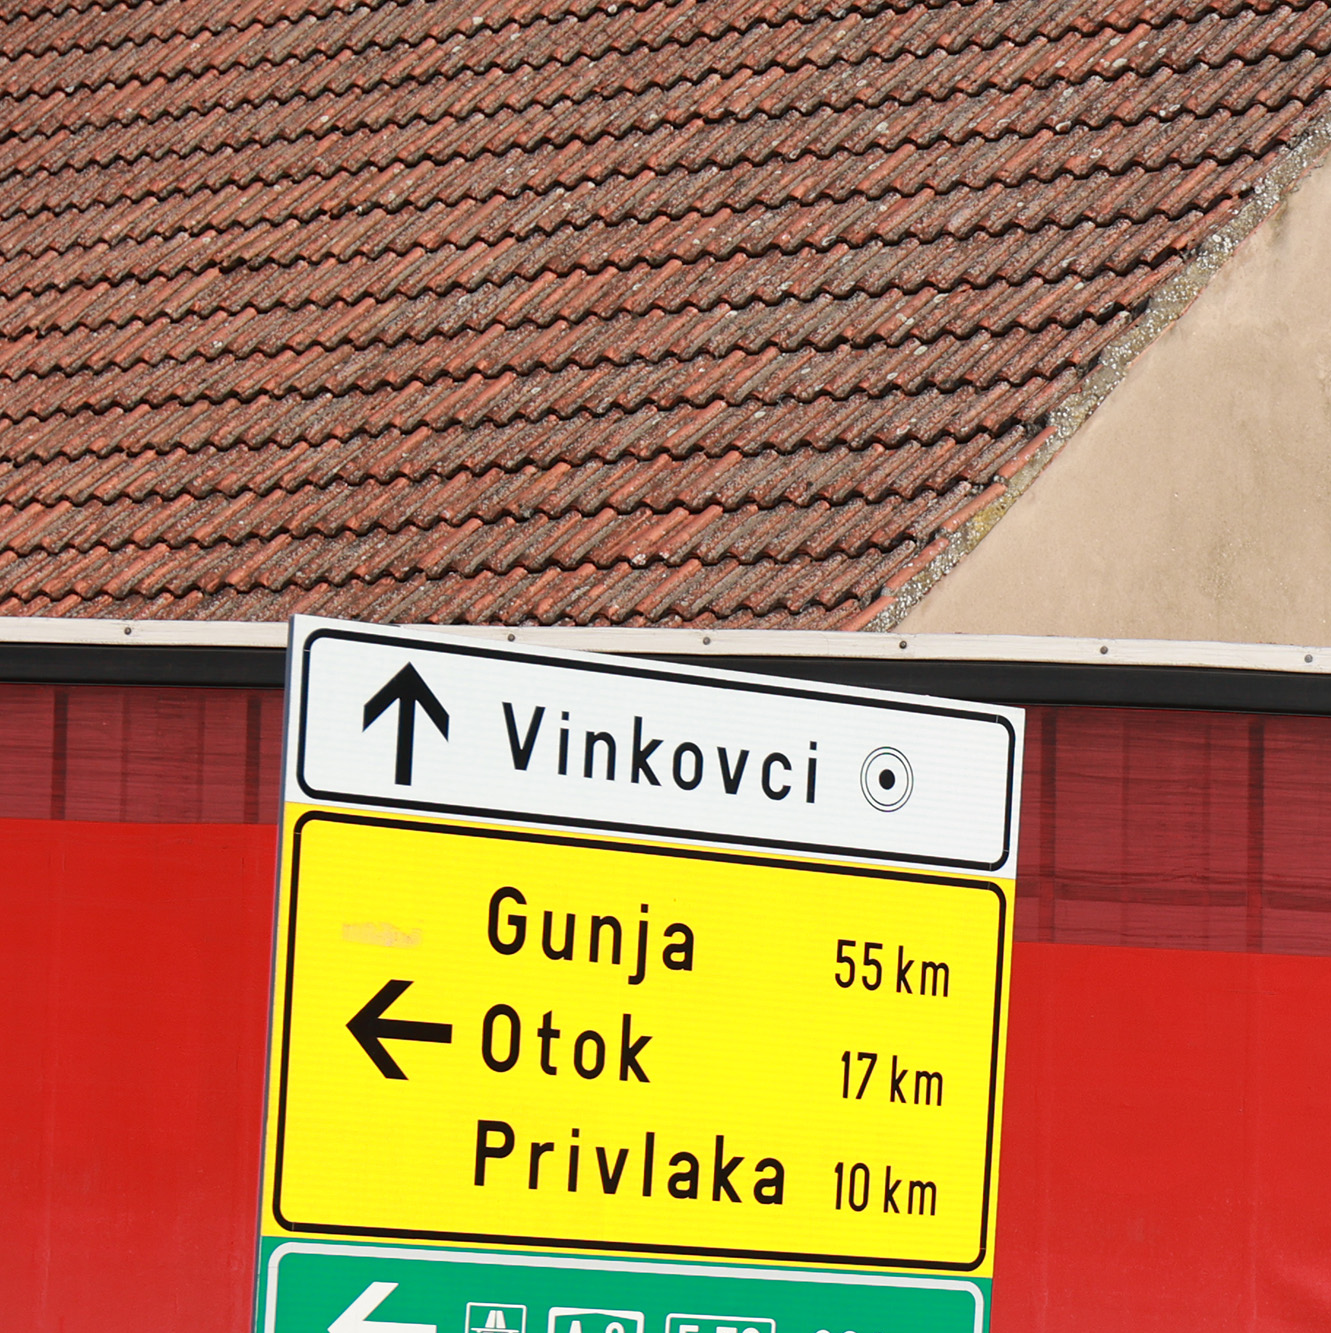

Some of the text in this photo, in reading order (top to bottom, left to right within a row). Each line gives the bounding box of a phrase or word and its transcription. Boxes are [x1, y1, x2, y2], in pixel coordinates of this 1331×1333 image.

[502, 702, 819, 804] Vinkovci
[487, 886, 950, 998] Gunja 55 km
[481, 1003, 943, 1107] Otok 17 km
[474, 1119, 937, 1216] Privlaka 10 km
